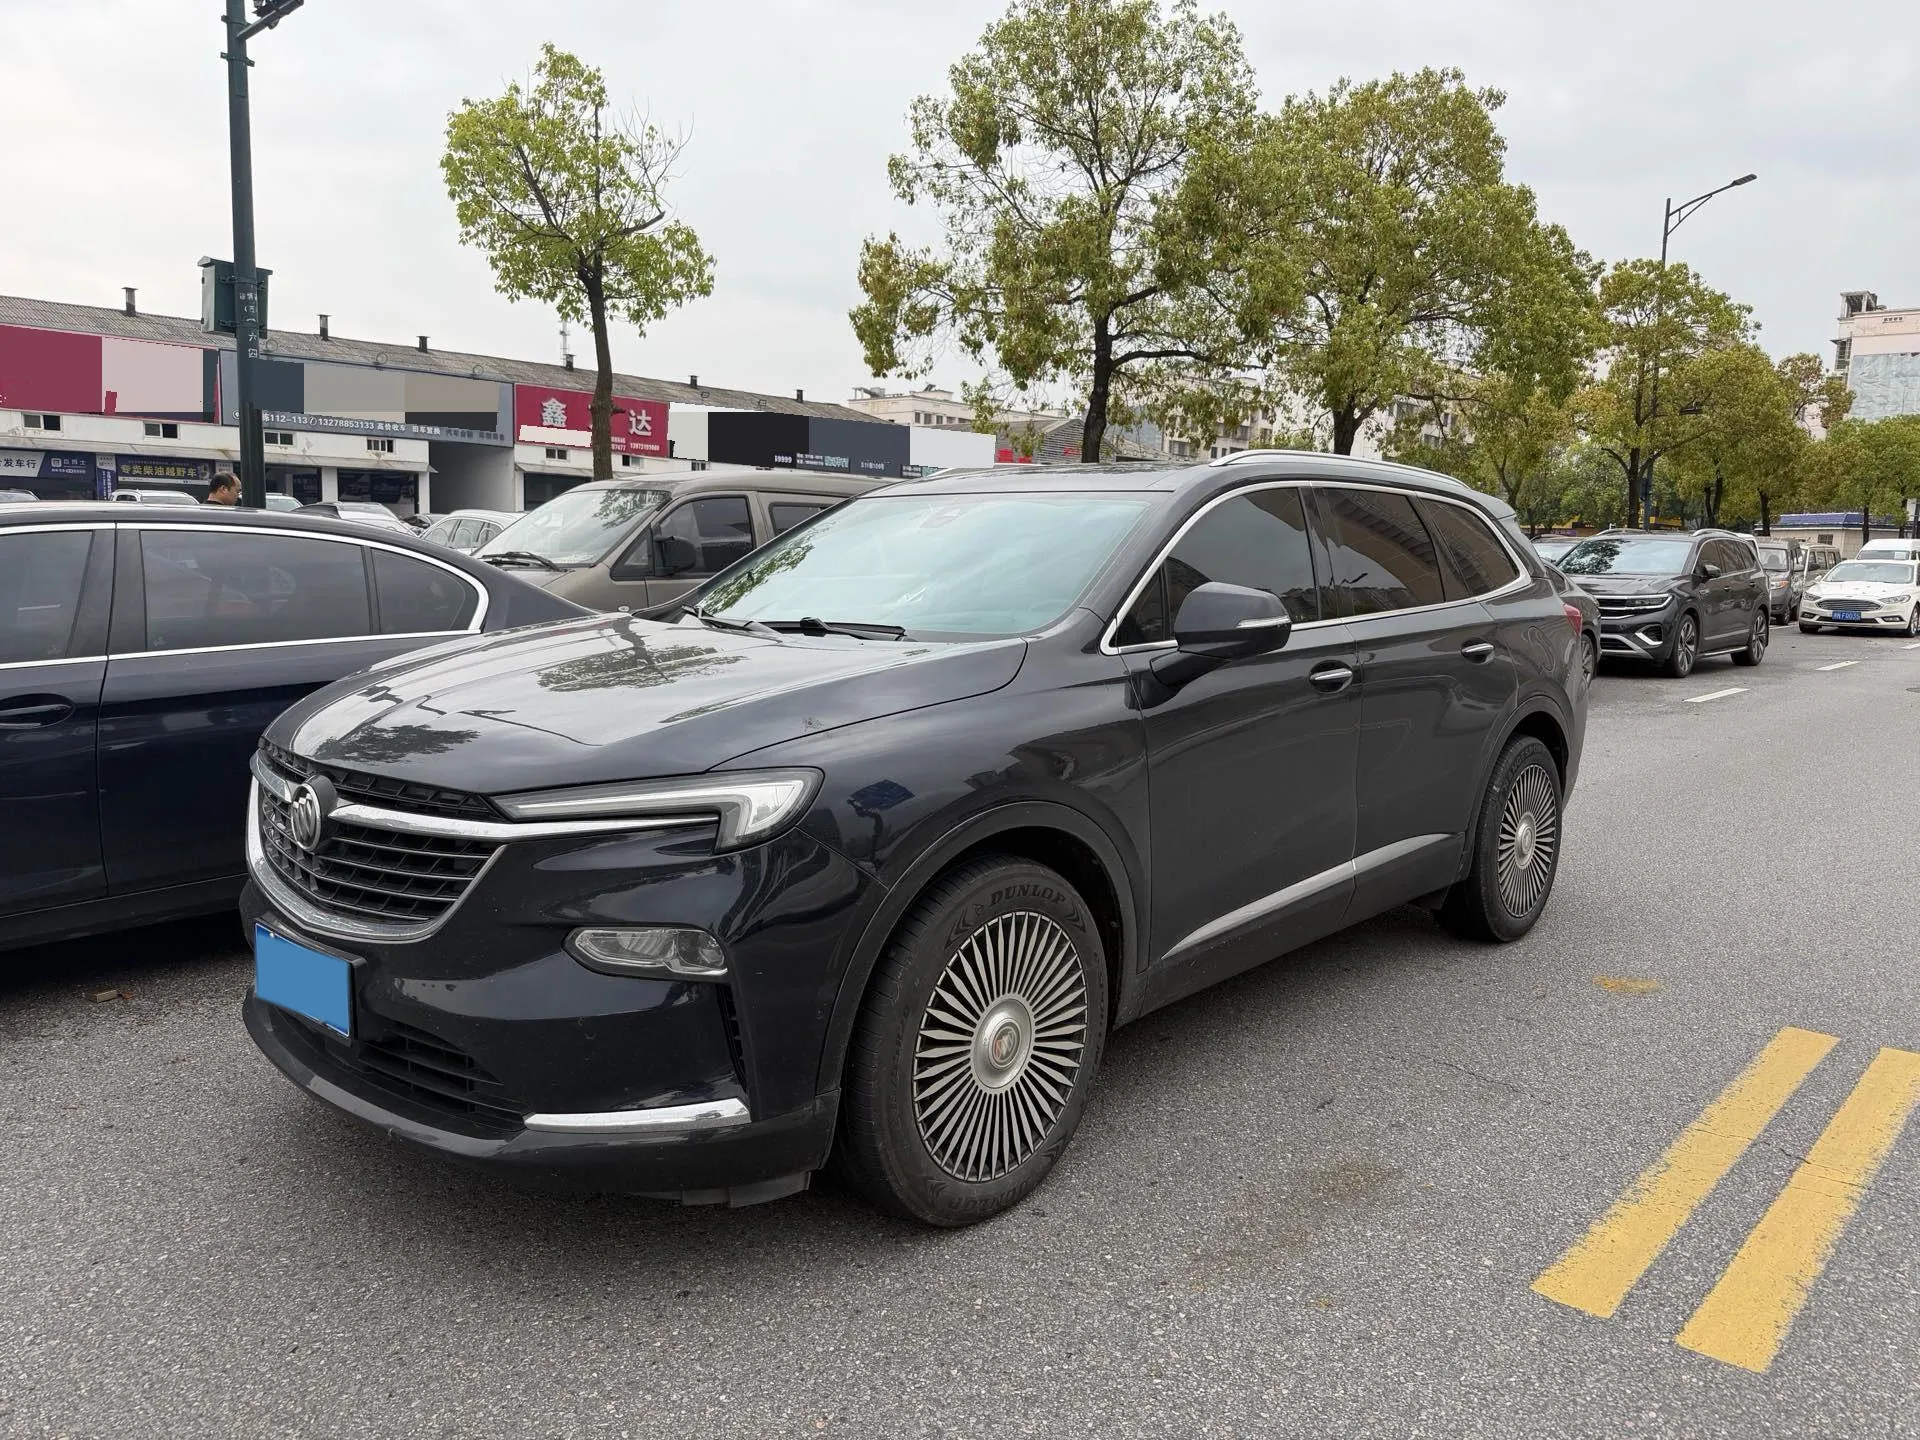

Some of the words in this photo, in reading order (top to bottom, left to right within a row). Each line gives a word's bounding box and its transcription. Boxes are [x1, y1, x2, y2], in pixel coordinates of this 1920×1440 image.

[0, 458, 37, 469] 发车行
[990, 884, 1066, 906] DUNLOP
